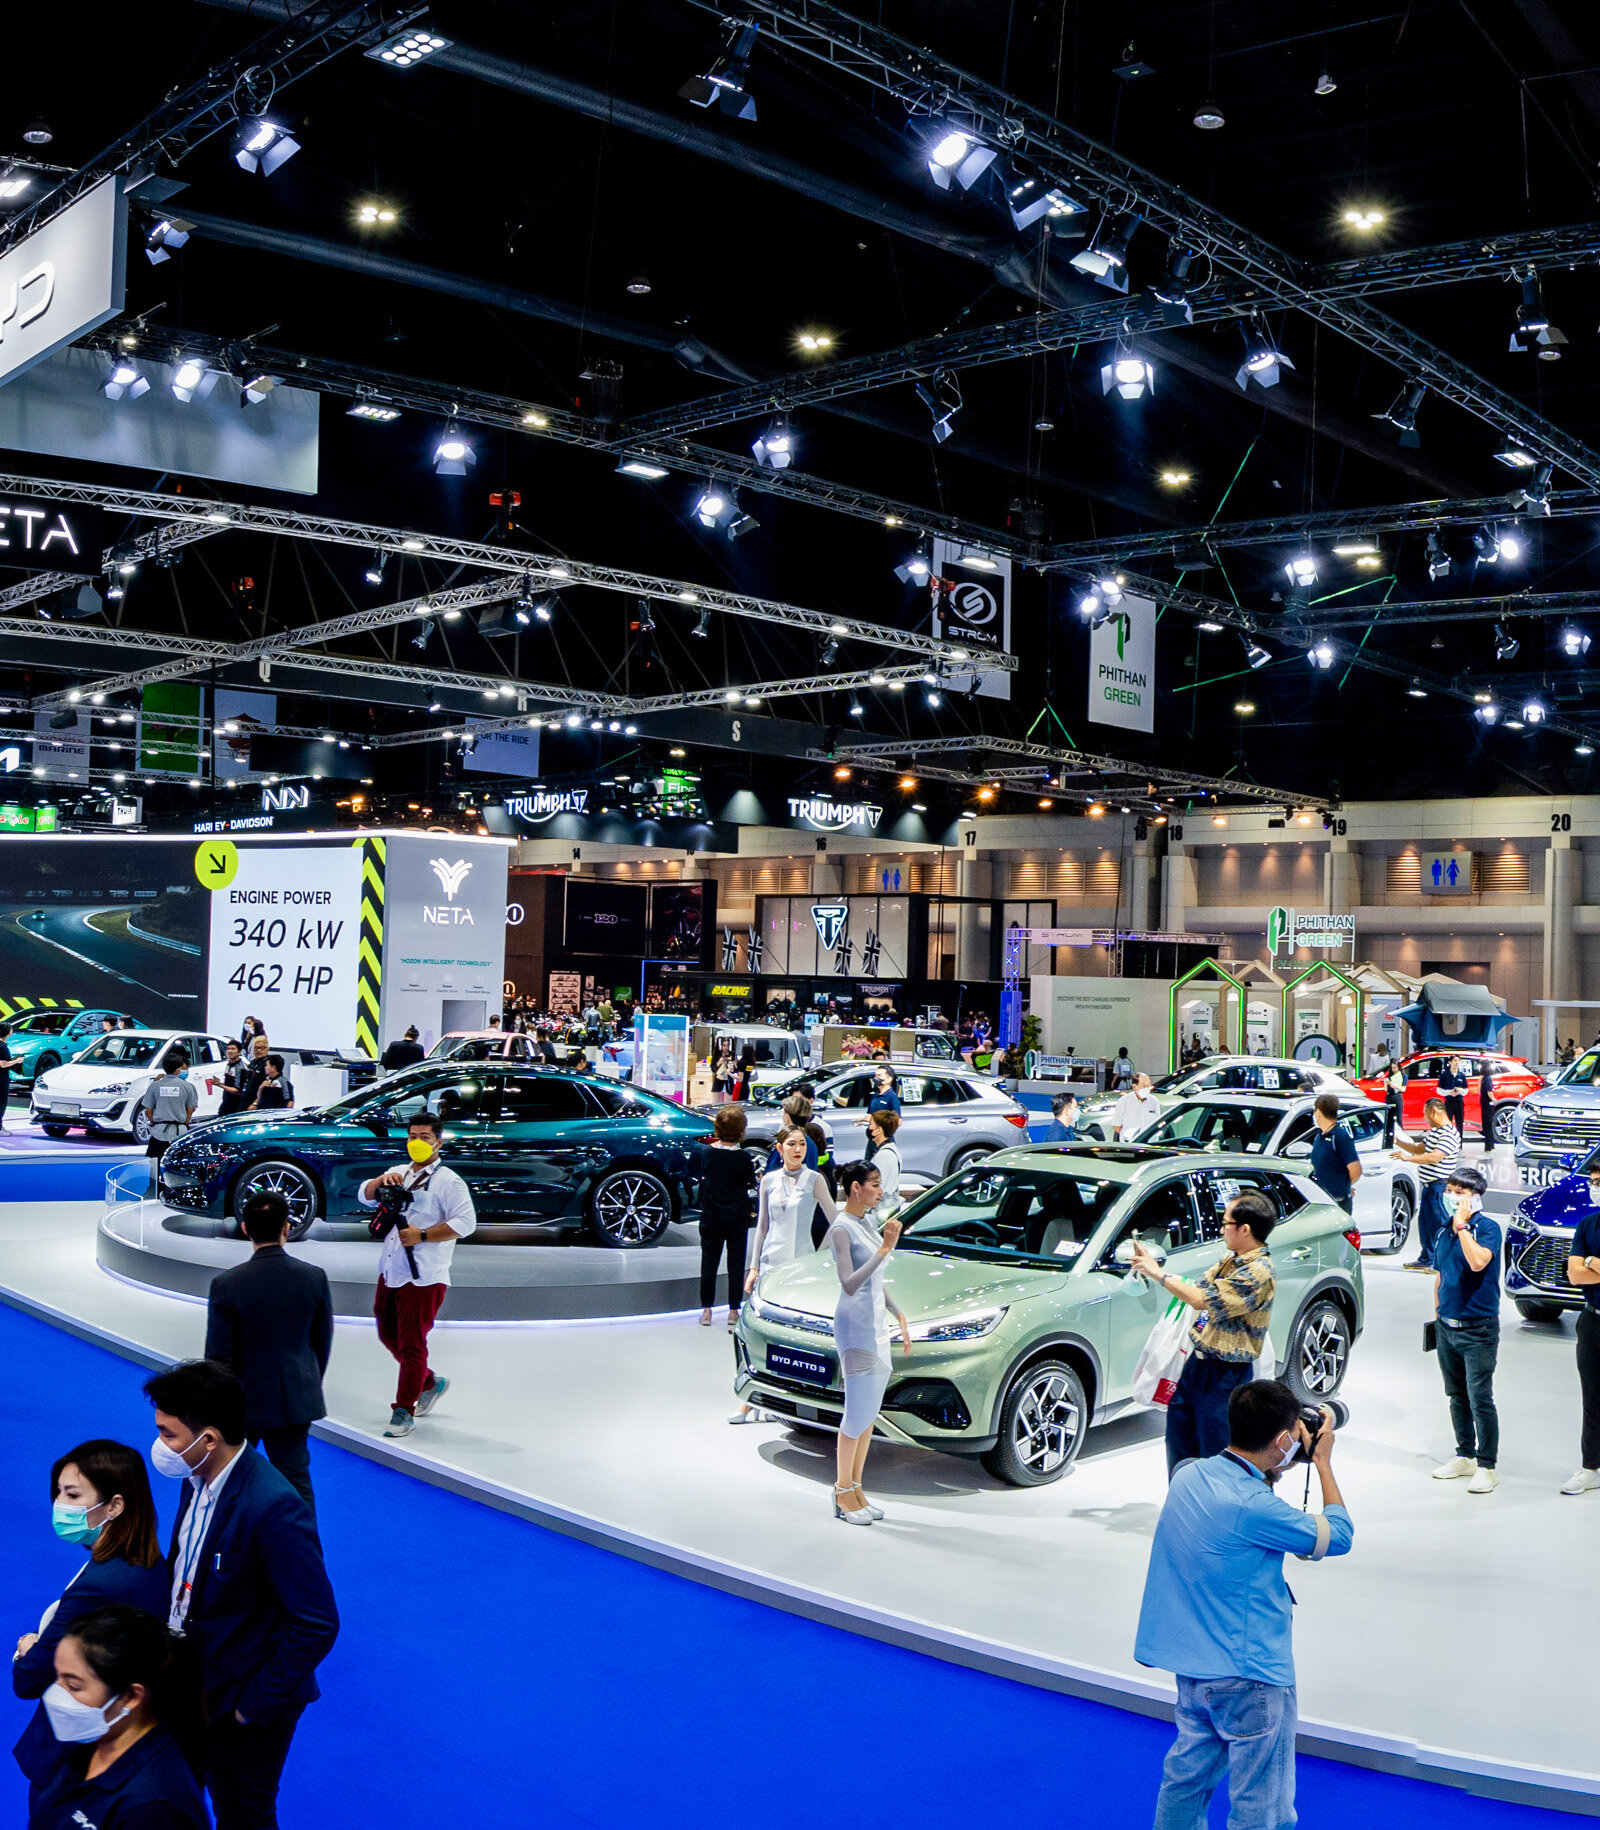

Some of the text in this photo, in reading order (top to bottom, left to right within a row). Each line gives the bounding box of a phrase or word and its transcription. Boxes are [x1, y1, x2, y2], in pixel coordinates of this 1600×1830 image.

[948, 625, 997, 644] STROM
[1099, 664, 1147, 689] PHITHAN
[1104, 686, 1141, 707] GREEN
[495, 733, 510, 743] THE
[512, 735, 529, 745] RIDE
[732, 720, 741, 742] S
[504, 791, 571, 820] TRIUMPH
[788, 797, 864, 829] TRIUMPH
[1332, 818, 1347, 836] 19
[1551, 813, 1572, 832] 20
[964, 832, 976, 846] 17
[1168, 824, 1183, 841] 18
[815, 837, 826, 850] 16
[230, 890, 331, 905] ENGINE POWER
[423, 905, 475, 926] NETA
[1297, 915, 1354, 928] PHITHAN
[229, 918, 344, 949] 340 kW
[1297, 933, 1342, 946] GREEN
[228, 963, 333, 995] 462 HP
[712, 985, 751, 997] RACING
[861, 985, 889, 996] TRIUMPH
[1041, 1056, 1095, 1066] PHITHAN GREEN
[771, 1354, 826, 1373] BYD ATTO 3
